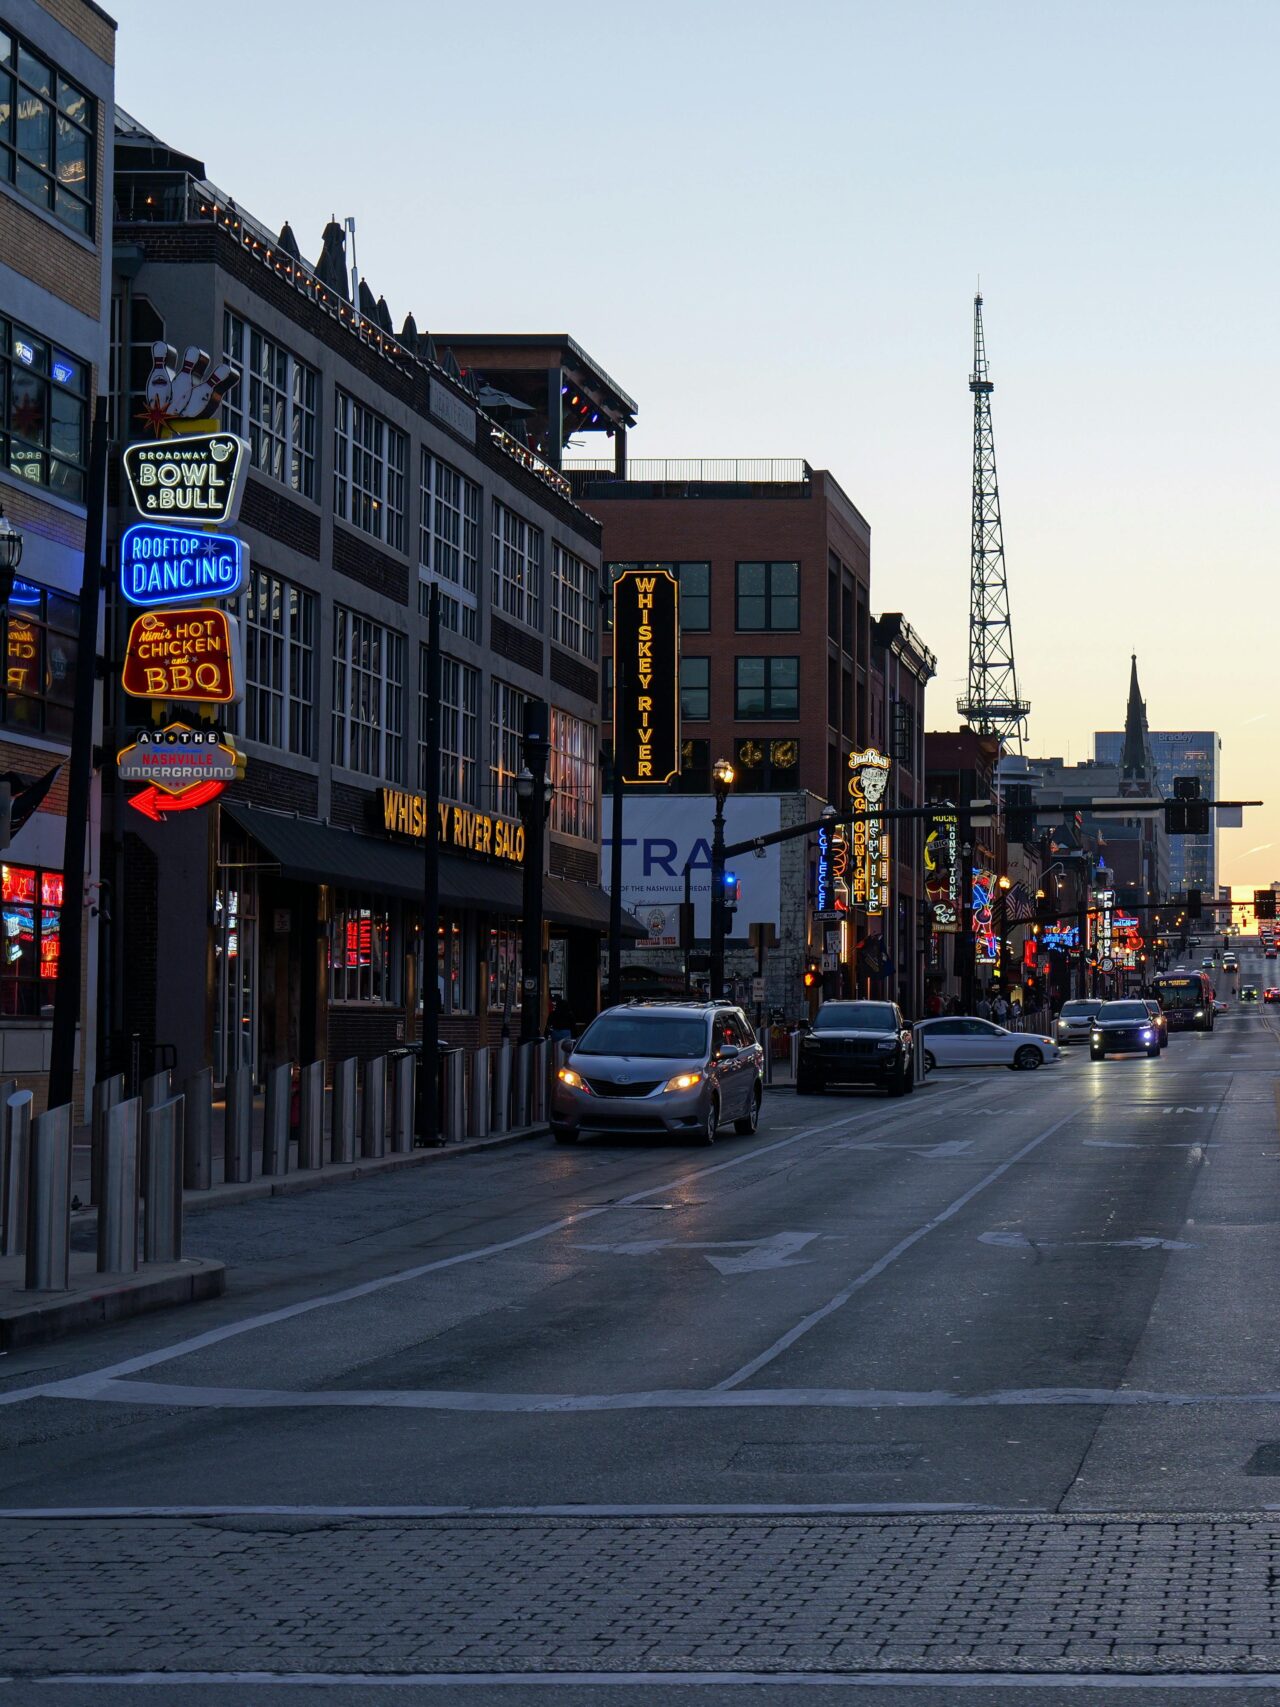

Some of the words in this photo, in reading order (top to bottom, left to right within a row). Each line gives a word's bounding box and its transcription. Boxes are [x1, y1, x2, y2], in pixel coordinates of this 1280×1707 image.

[139, 452, 207, 460] BROADWAY
[140, 463, 225, 486] BOWL
[132, 537, 199, 559] ROOFTOP
[133, 556, 233, 595] DANCING
[176, 620, 216, 639] HOT
[635, 577, 656, 689] WHISKEY
[138, 636, 221, 660] CHICKEN
[171, 656, 189, 665] and
[144, 663, 223, 694] BBQ
[139, 733, 163, 743] AT
[181, 733, 216, 743] THE
[637, 696, 653, 777] RIVER
[142, 753, 213, 765] NASHVILLE
[121, 766, 235, 778] UNDERGROUND
[383, 787, 450, 842] WHISY
[454, 807, 491, 854] RIVER
[494, 819, 526, 862] SALO
[854, 798, 865, 902] GODNIGHT
[948, 824, 957, 864] HONKY
[1103, 891, 1113, 957] FRIENDS
[41, 962, 59, 978] LATE
